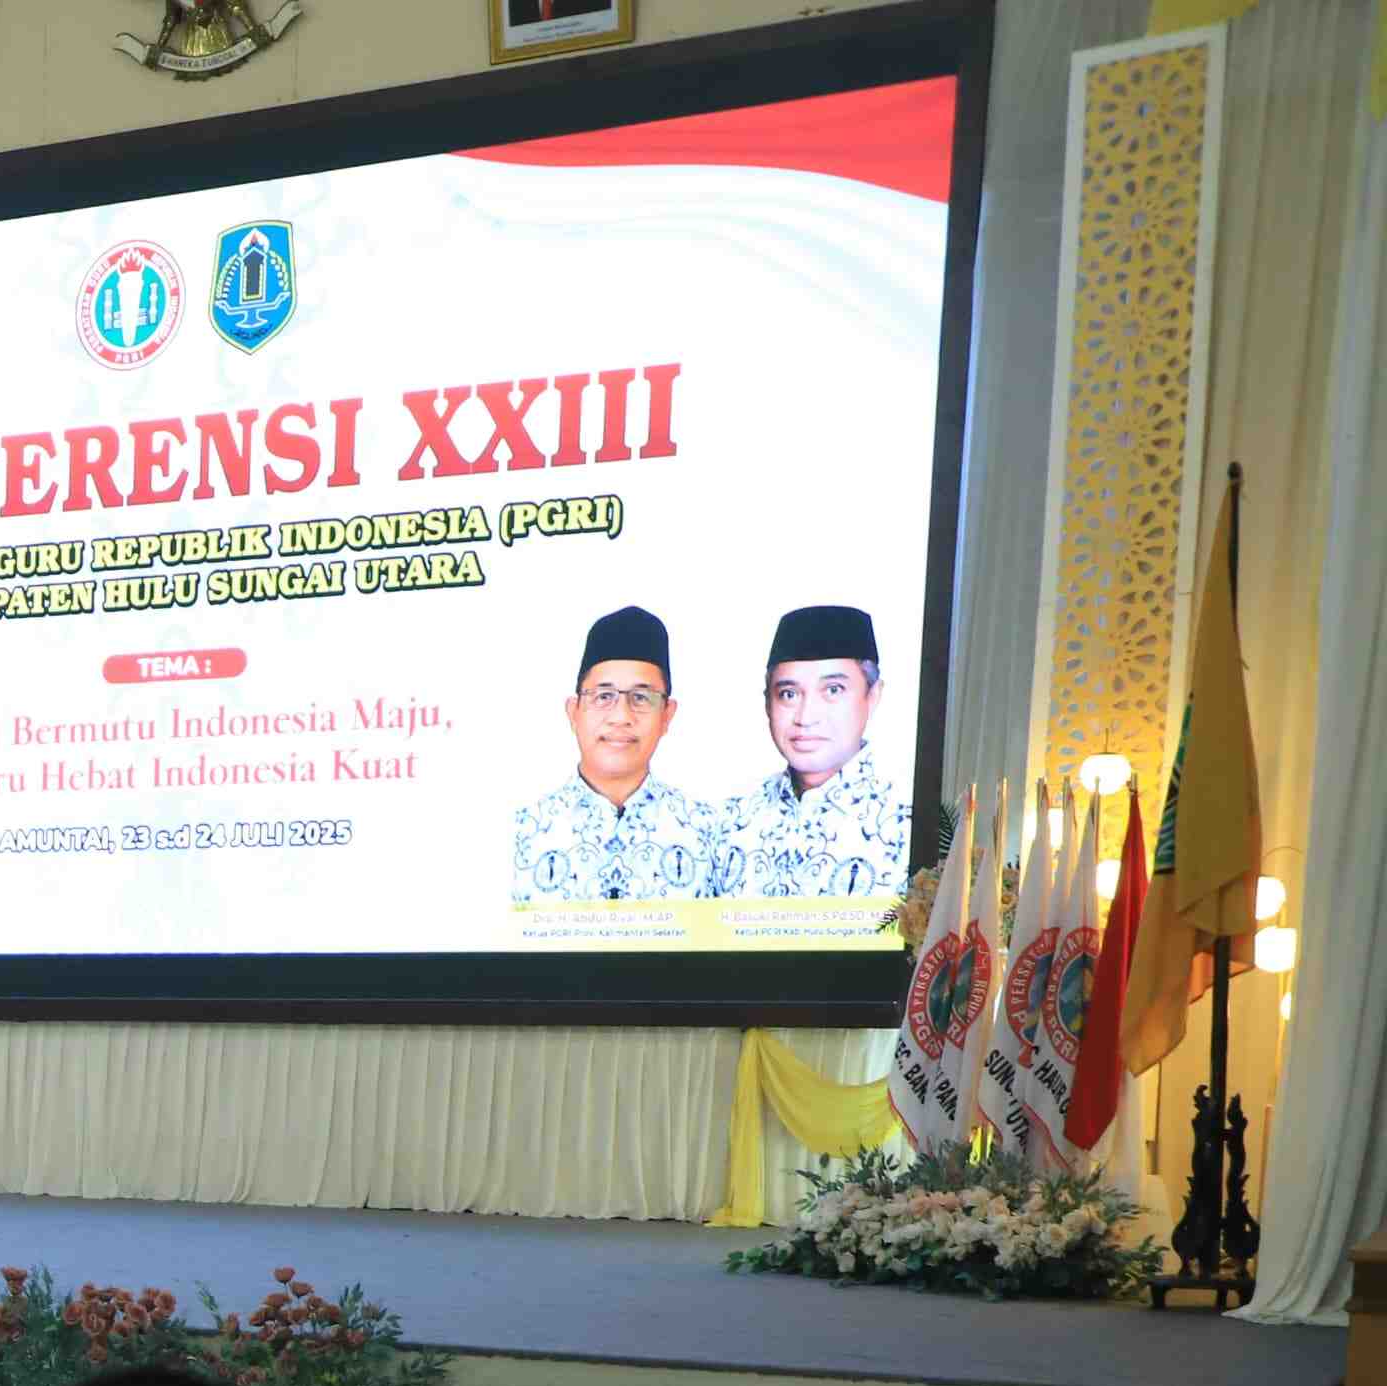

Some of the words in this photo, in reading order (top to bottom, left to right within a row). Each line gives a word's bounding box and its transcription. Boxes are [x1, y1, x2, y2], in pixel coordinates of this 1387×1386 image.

[399, 362, 683, 482] XXIII
[91, 525, 271, 572] REPUBLIK
[278, 507, 491, 559] INDONESIA
[499, 494, 624, 544] (PGRI)
[103, 576, 200, 615] HULU
[206, 563, 348, 607] SUNGAI
[353, 552, 486, 593] UTARA
[136, 658, 198, 678] TEMA
[11, 710, 157, 748] Bermutu
[168, 704, 339, 740] Indonesia
[352, 696, 454, 737] Maju,
[40, 757, 137, 793] Hebat
[151, 750, 317, 787] Indonesia
[332, 748, 418, 781] Kuat
[121, 826, 152, 853] 23
[195, 824, 227, 850] 24
[229, 822, 284, 849] JULI
[288, 820, 353, 847] 2025
